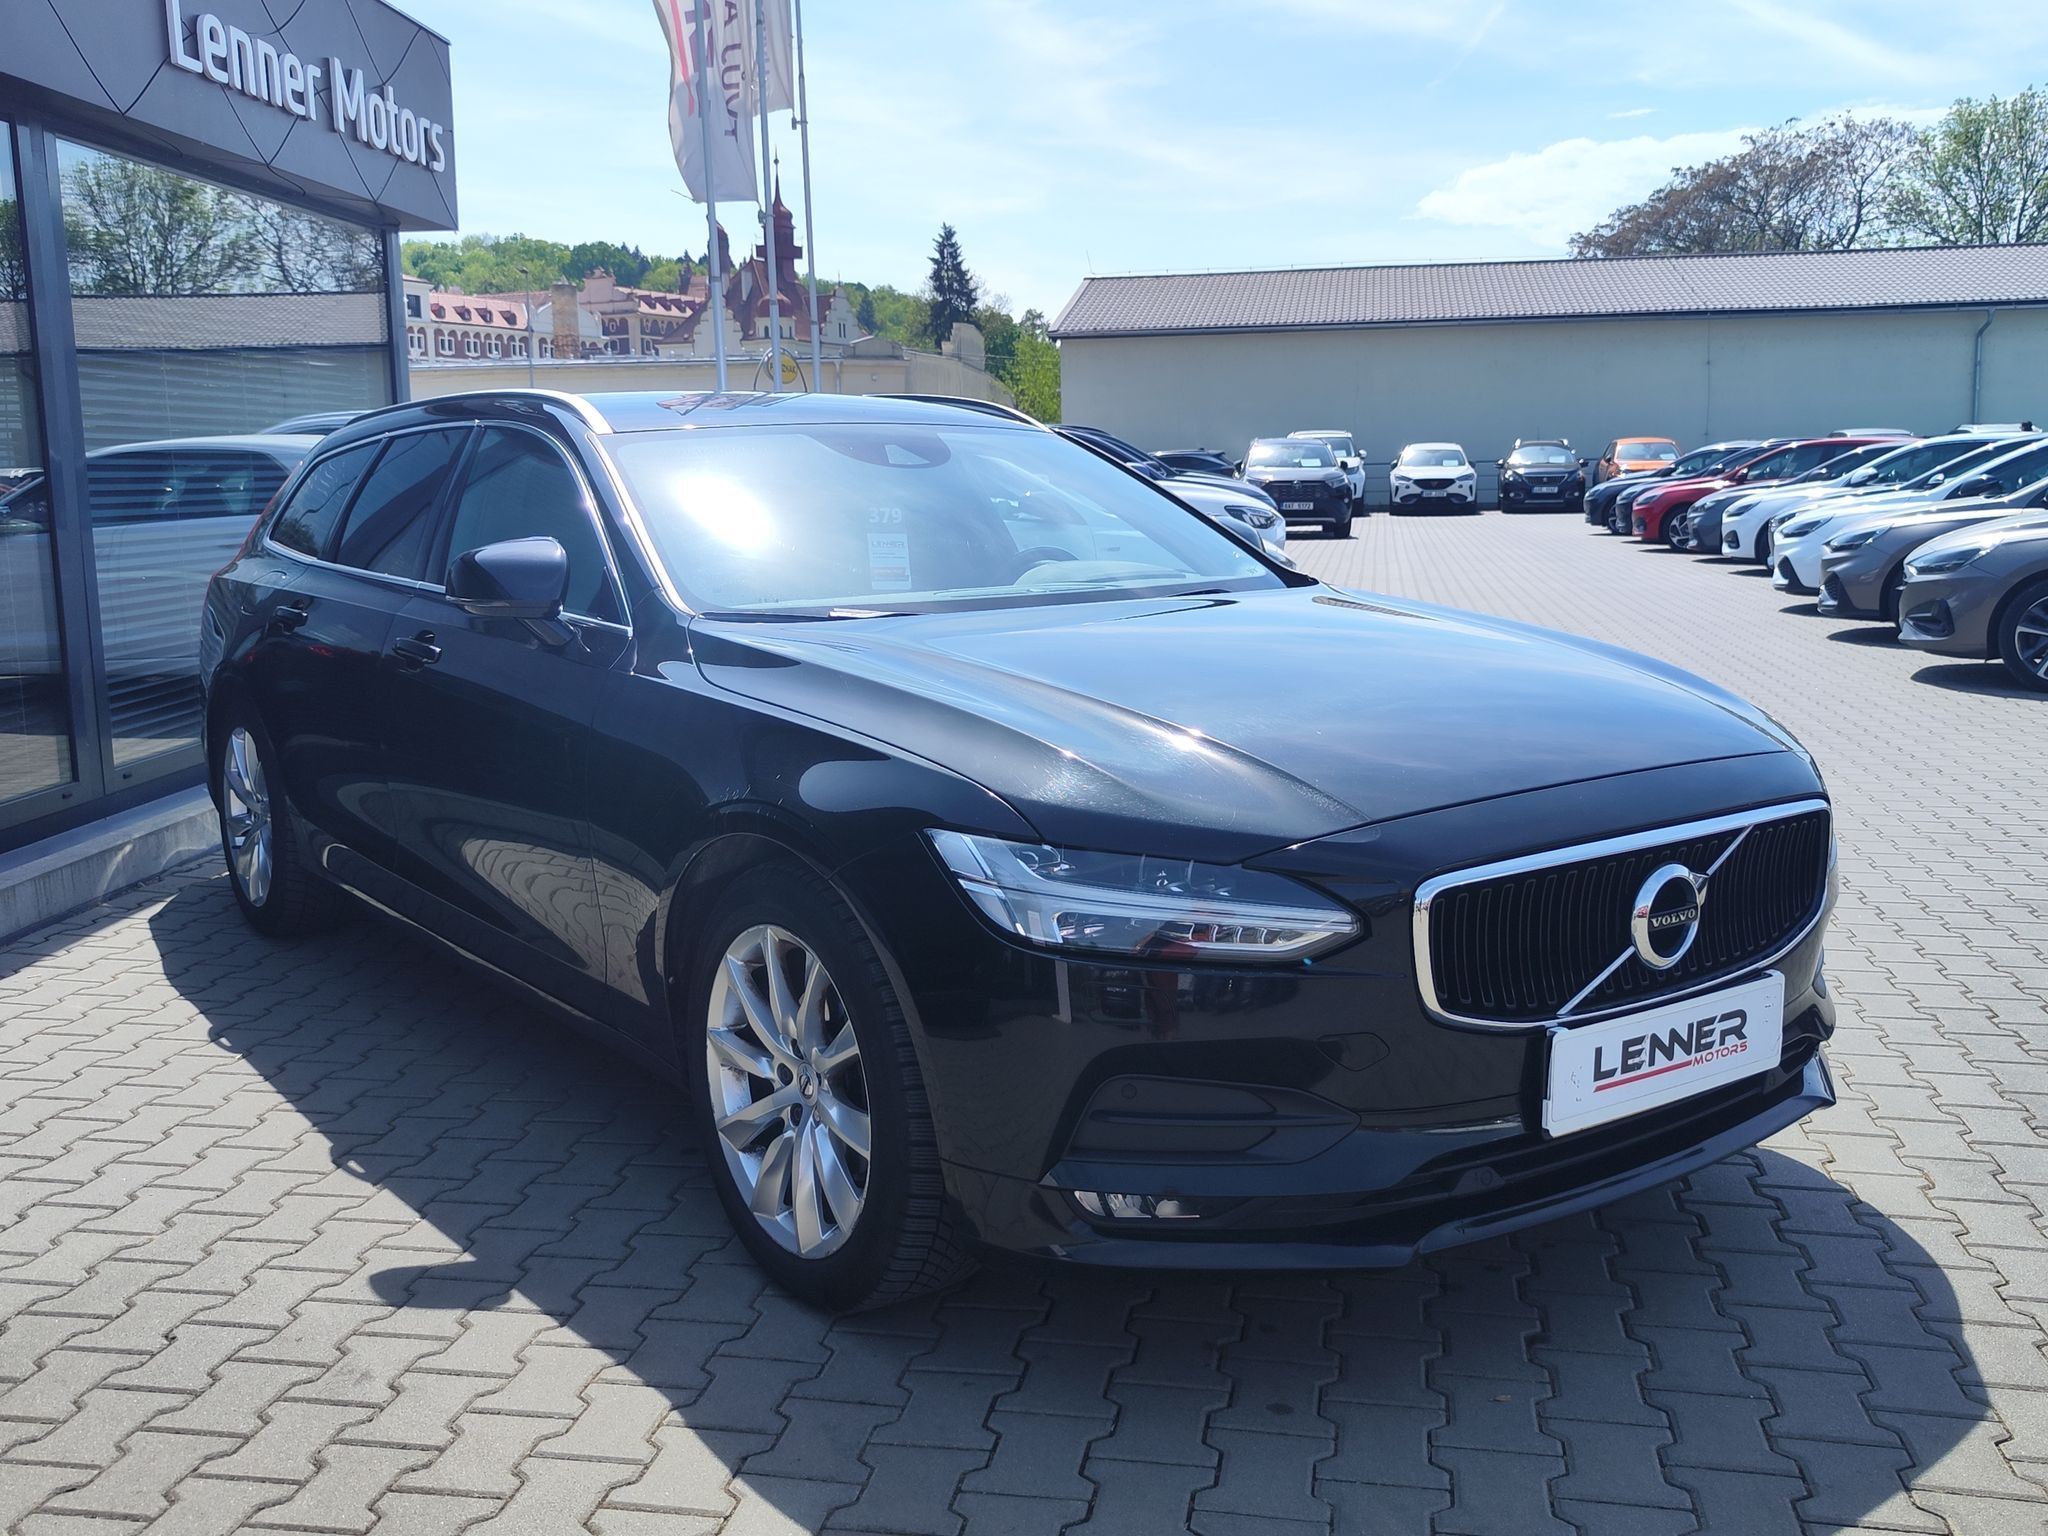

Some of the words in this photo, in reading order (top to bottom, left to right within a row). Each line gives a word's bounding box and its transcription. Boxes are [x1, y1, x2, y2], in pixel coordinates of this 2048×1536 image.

[165, 0, 321, 121] Lenner
[328, 56, 446, 173] Motors
[868, 507, 902, 523] 379
[1650, 908, 1697, 928] VOLVO
[1593, 1008, 1749, 1082] LENNER
[1692, 1041, 1749, 1067] MOTORS
